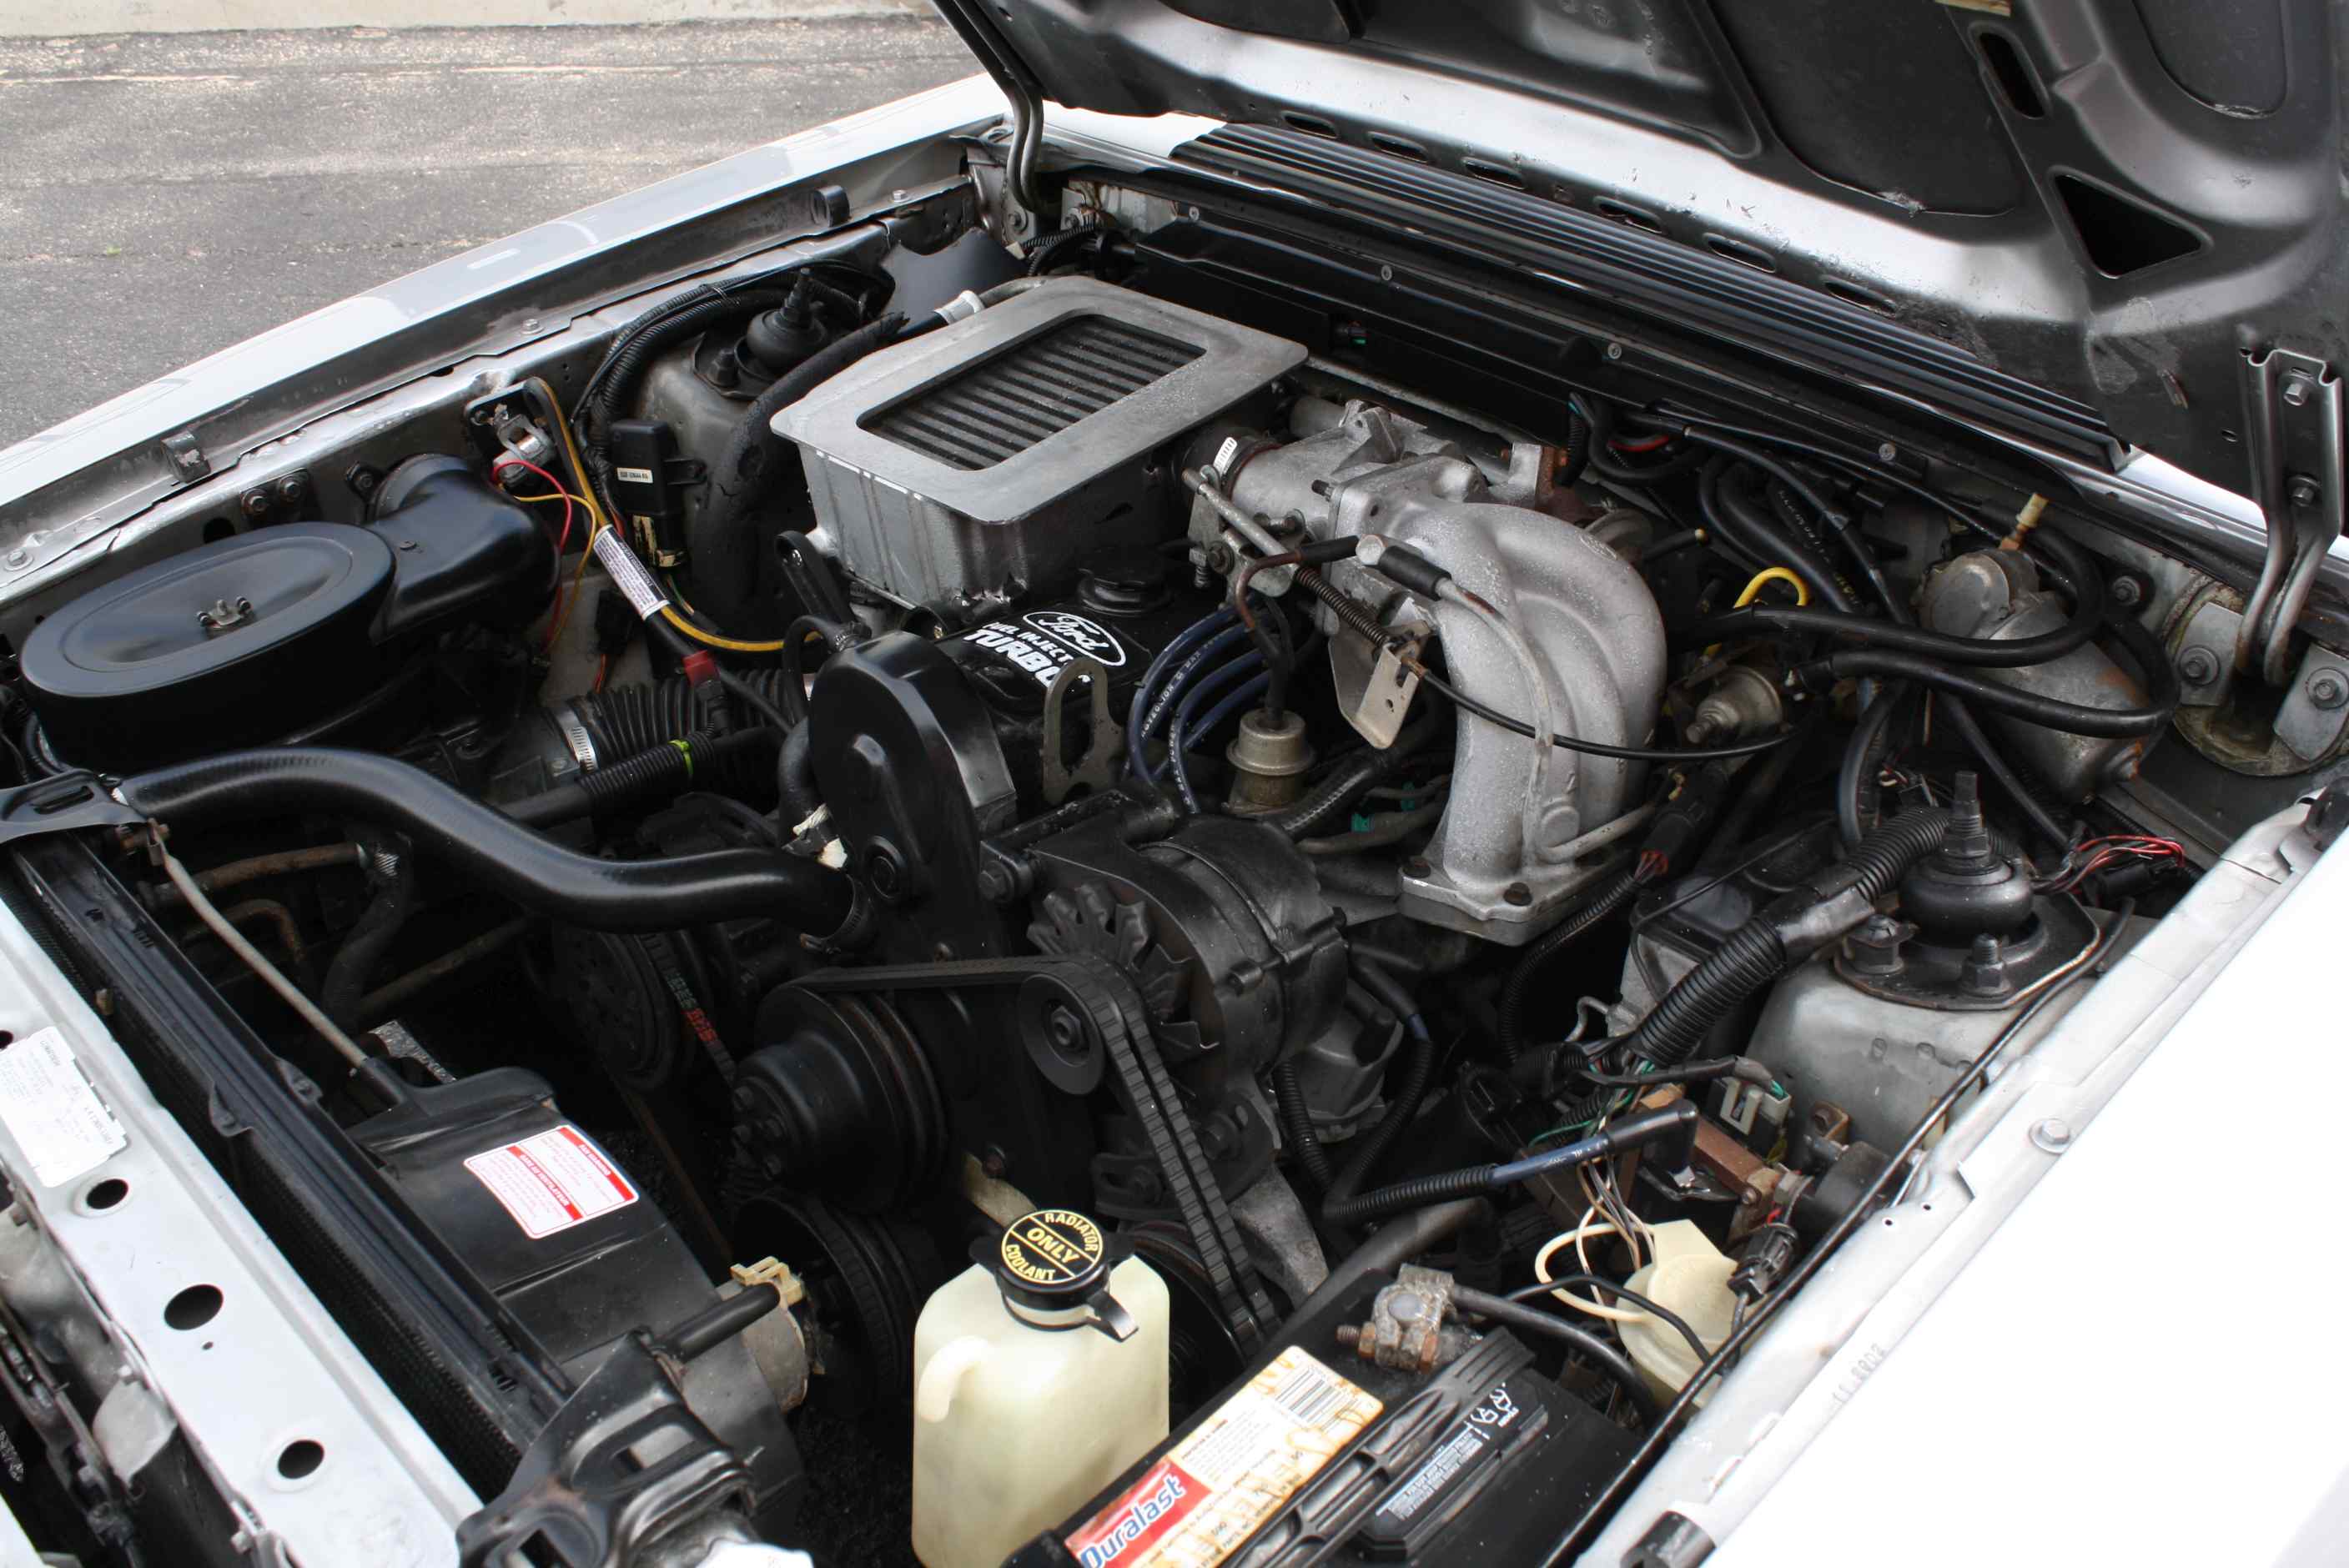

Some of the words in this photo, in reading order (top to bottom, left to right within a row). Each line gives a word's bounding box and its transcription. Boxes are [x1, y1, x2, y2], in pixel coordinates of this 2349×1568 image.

[982, 621, 1020, 636] FUEL
[1017, 631, 1075, 666] INJECT
[1039, 616, 1109, 651] Ford
[1027, 1227, 1080, 1264] ONLY
[1044, 1212, 1099, 1252] RADIATOR
[1006, 1244, 1056, 1281] COOLANT
[1079, 1475, 1185, 1568] Duralast
